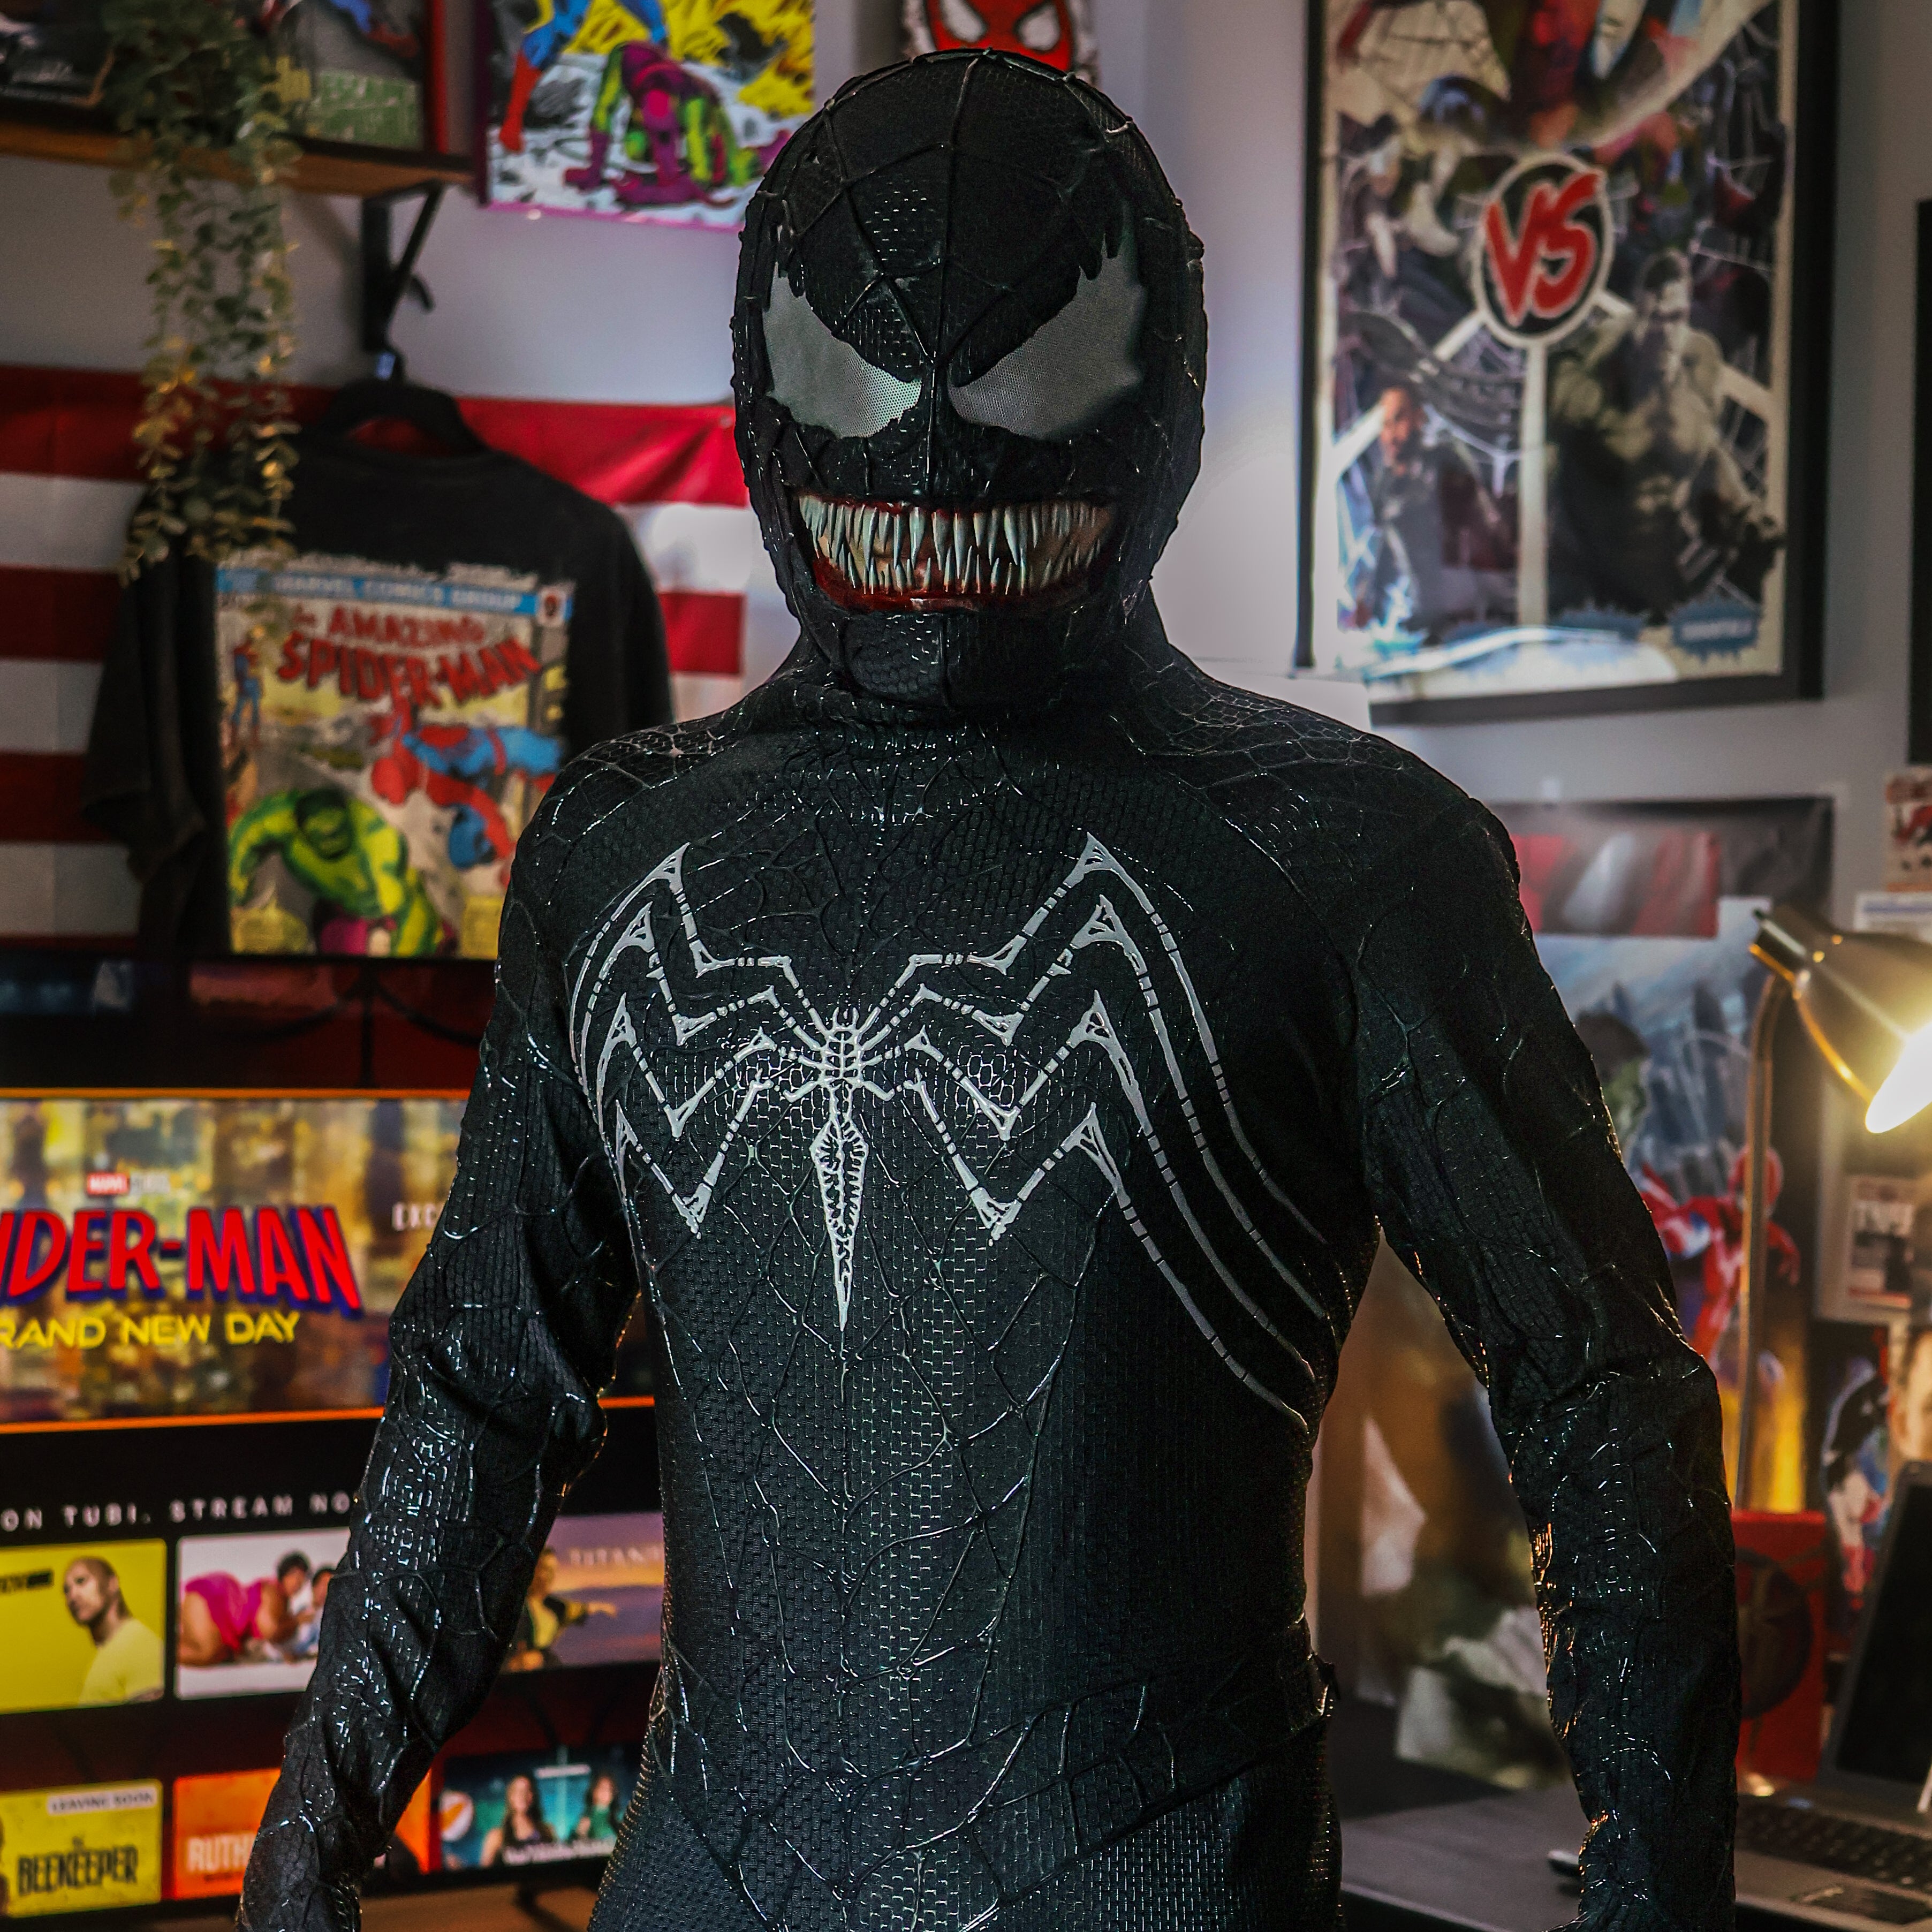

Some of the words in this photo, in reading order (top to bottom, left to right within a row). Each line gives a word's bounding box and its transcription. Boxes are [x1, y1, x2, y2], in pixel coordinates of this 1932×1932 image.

[1484, 171, 1601, 325] VS
[277, 630, 542, 708] SPIDER-MAN
[120, 1313, 211, 1345] NEW
[225, 1311, 300, 1344] DAY
[0, 1509, 43, 1532] ON
[62, 1503, 151, 1527] TUBI.
[168, 1494, 293, 1524] STREAM
[309, 1491, 350, 1515] NO
[18, 1845, 138, 1897] BEEKEEPER
[187, 1831, 255, 1873] RUTH
